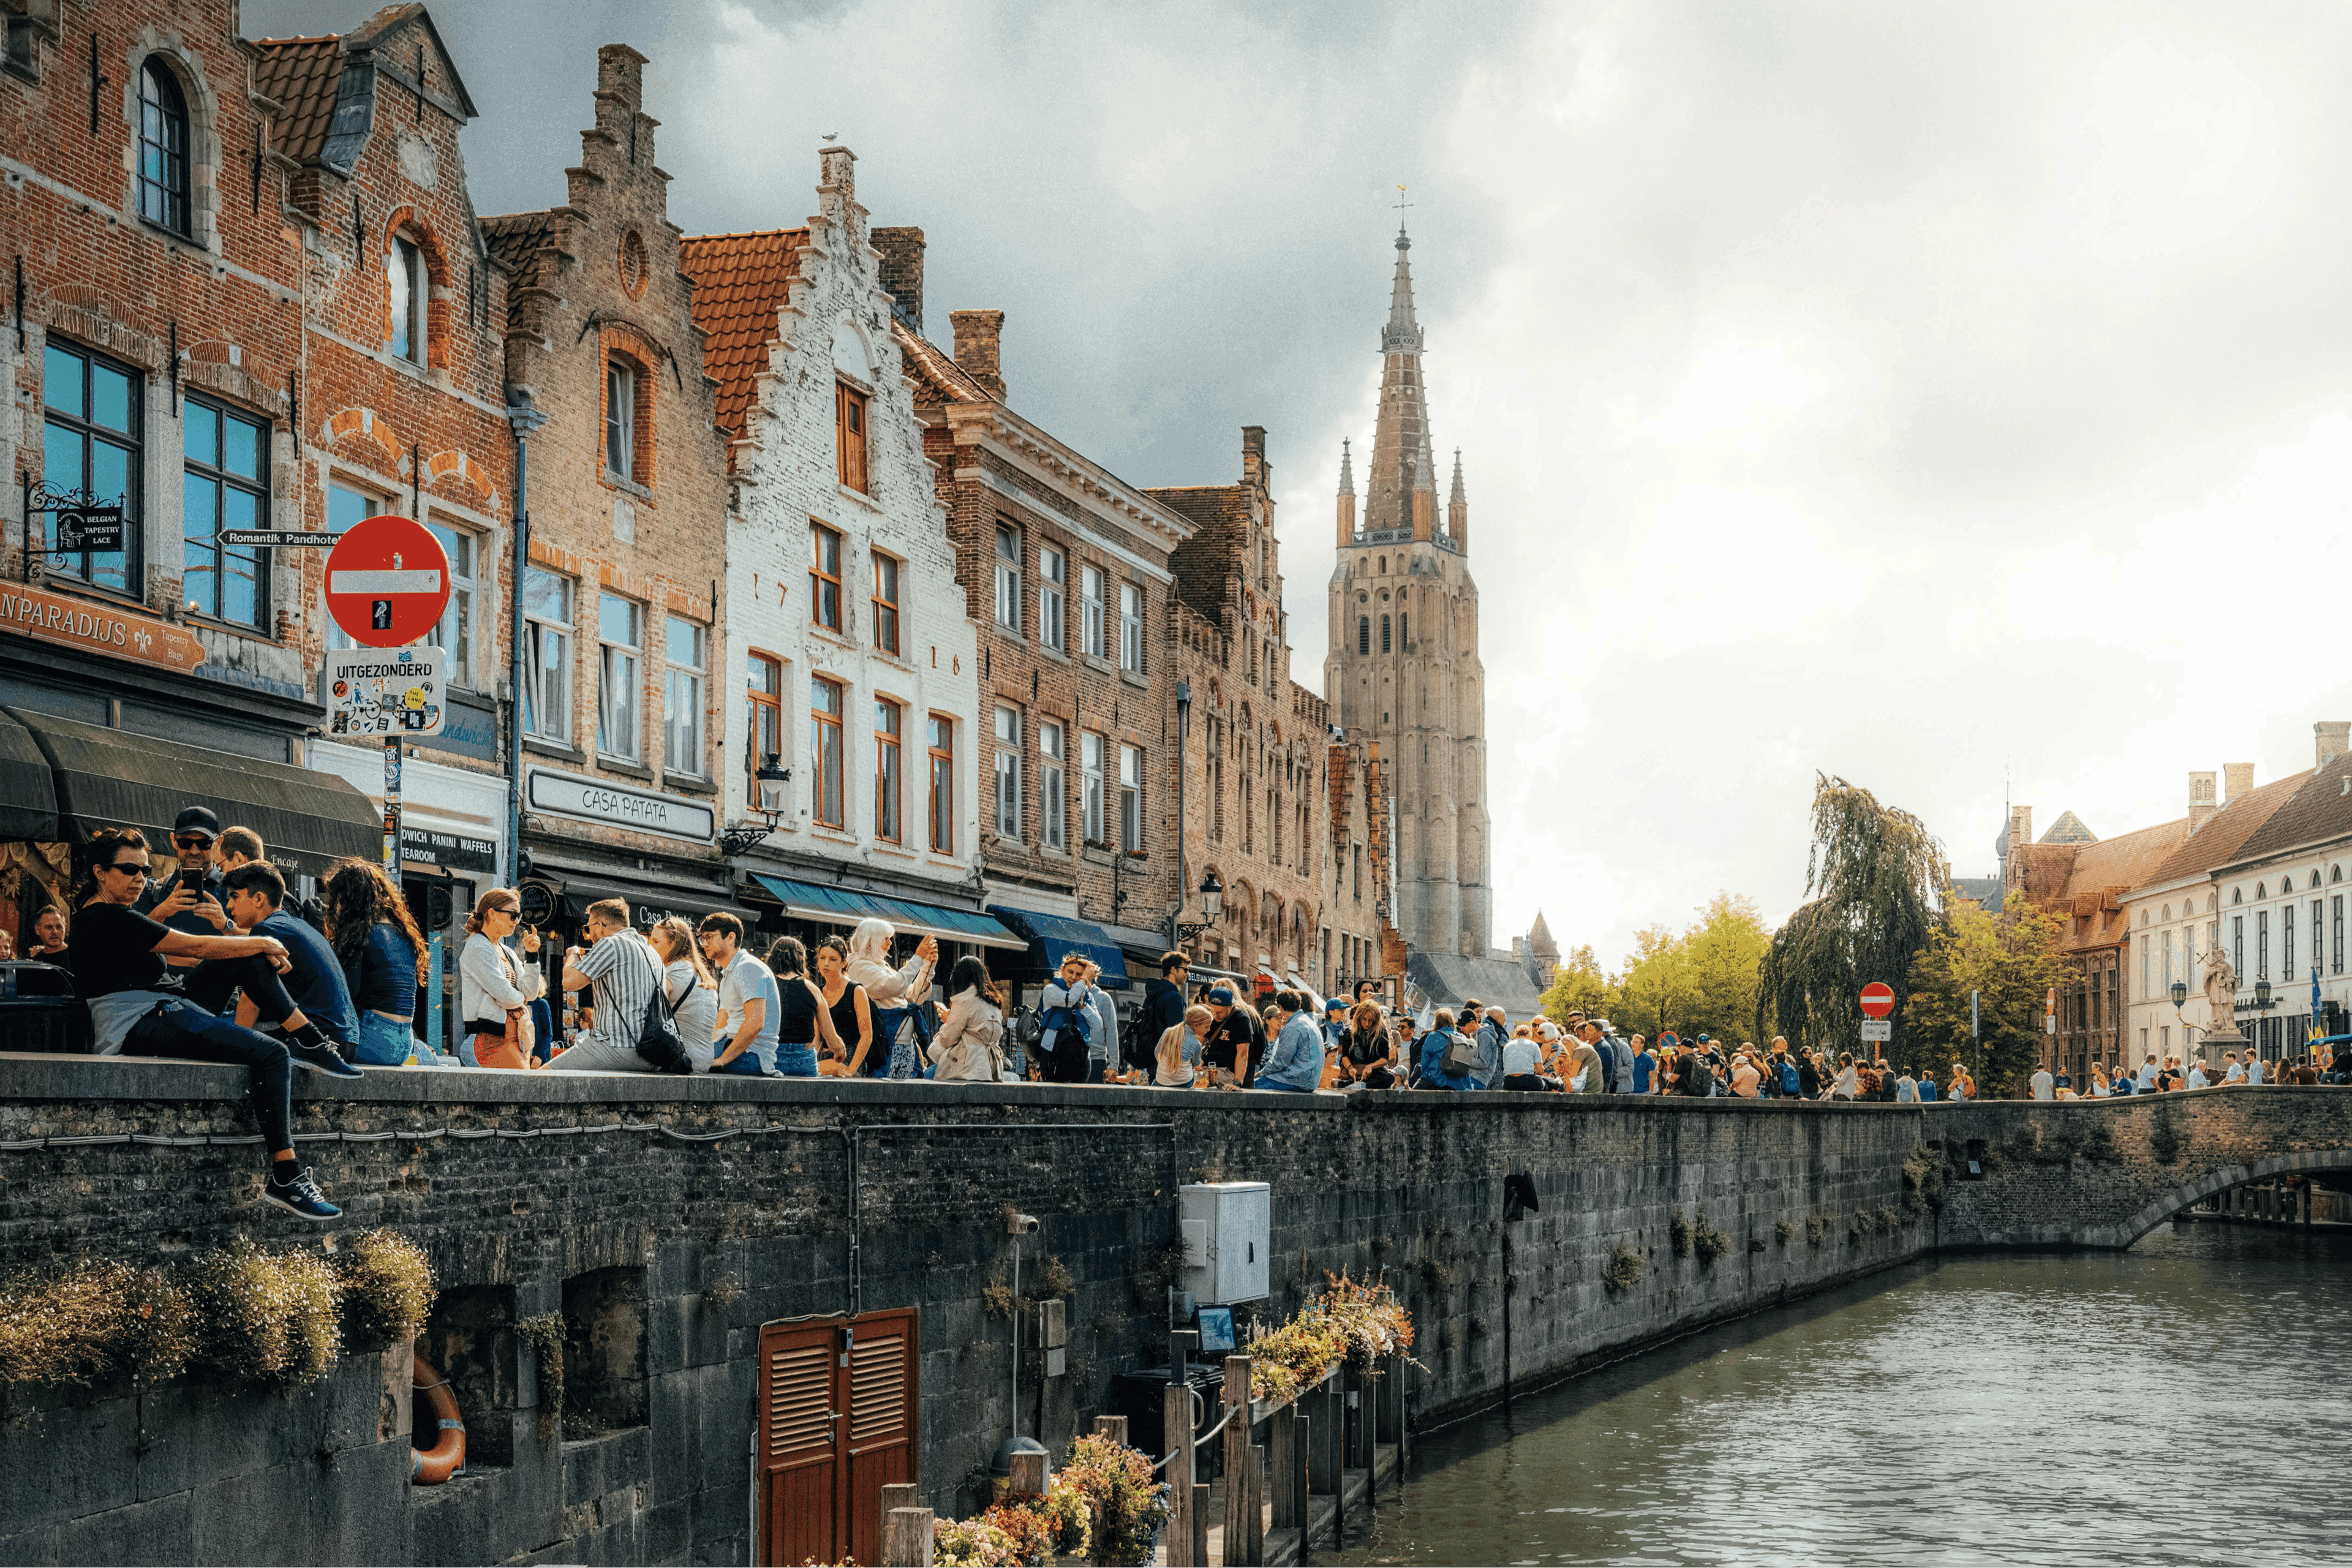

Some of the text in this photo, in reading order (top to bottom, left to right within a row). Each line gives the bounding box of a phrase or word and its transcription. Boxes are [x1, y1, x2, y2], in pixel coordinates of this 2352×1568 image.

[229, 533, 281, 543] Romantik
[161, 630, 189, 647] Tapestry
[168, 649, 184, 661] Bags
[337, 663, 432, 678] UITGEZONDERD
[582, 790, 667, 824] CASA PATATA
[402, 829, 492, 854] DWICH PANINI WAFFELS
[271, 854, 298, 871] Encaje
[401, 847, 435, 863] TEAROOM
[639, 906, 662, 925] Casa
